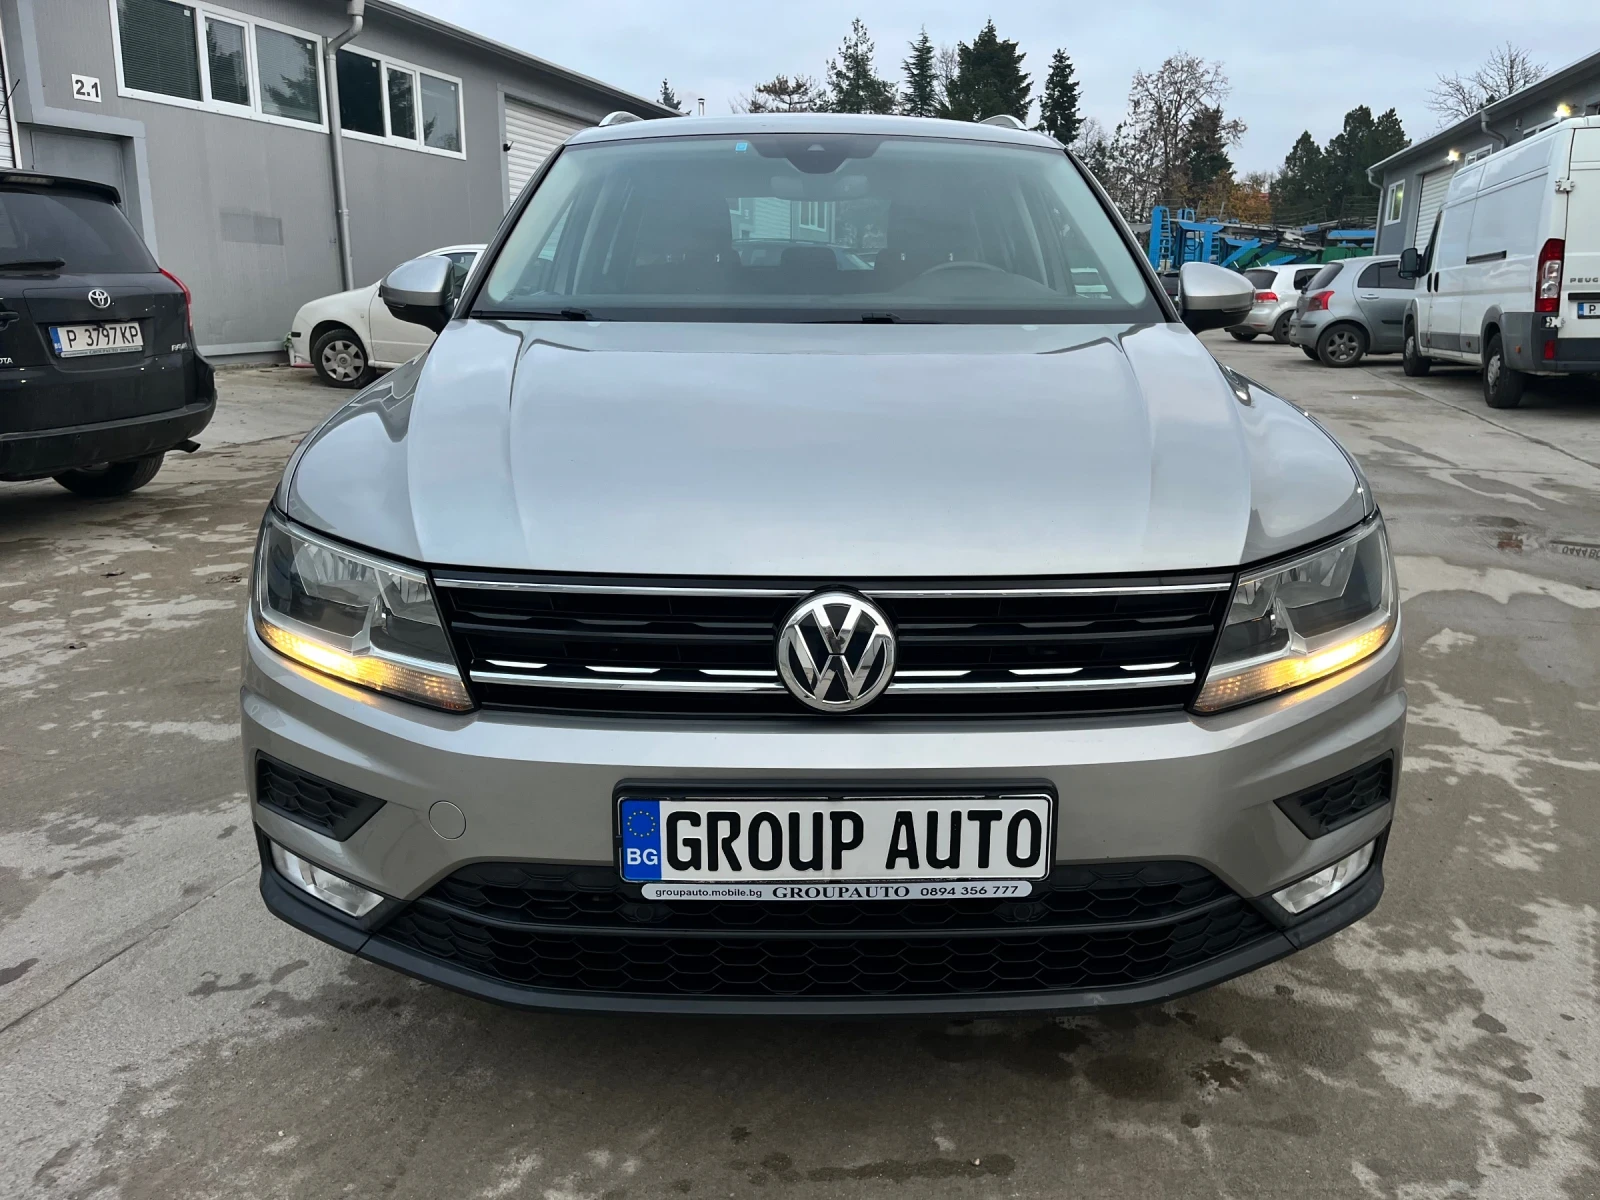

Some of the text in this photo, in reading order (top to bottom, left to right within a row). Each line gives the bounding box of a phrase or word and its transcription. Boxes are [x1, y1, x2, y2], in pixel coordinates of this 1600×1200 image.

[75, 79, 99, 98] 2.1
[1589, 304, 1596, 315] P
[66, 329, 77, 349] P
[666, 809, 1042, 872] GROUP AUTO
[626, 847, 659, 866] BG
[655, 884, 1019, 899] groupauto.mobile.bg GROUPAUTO 0894 356 777
